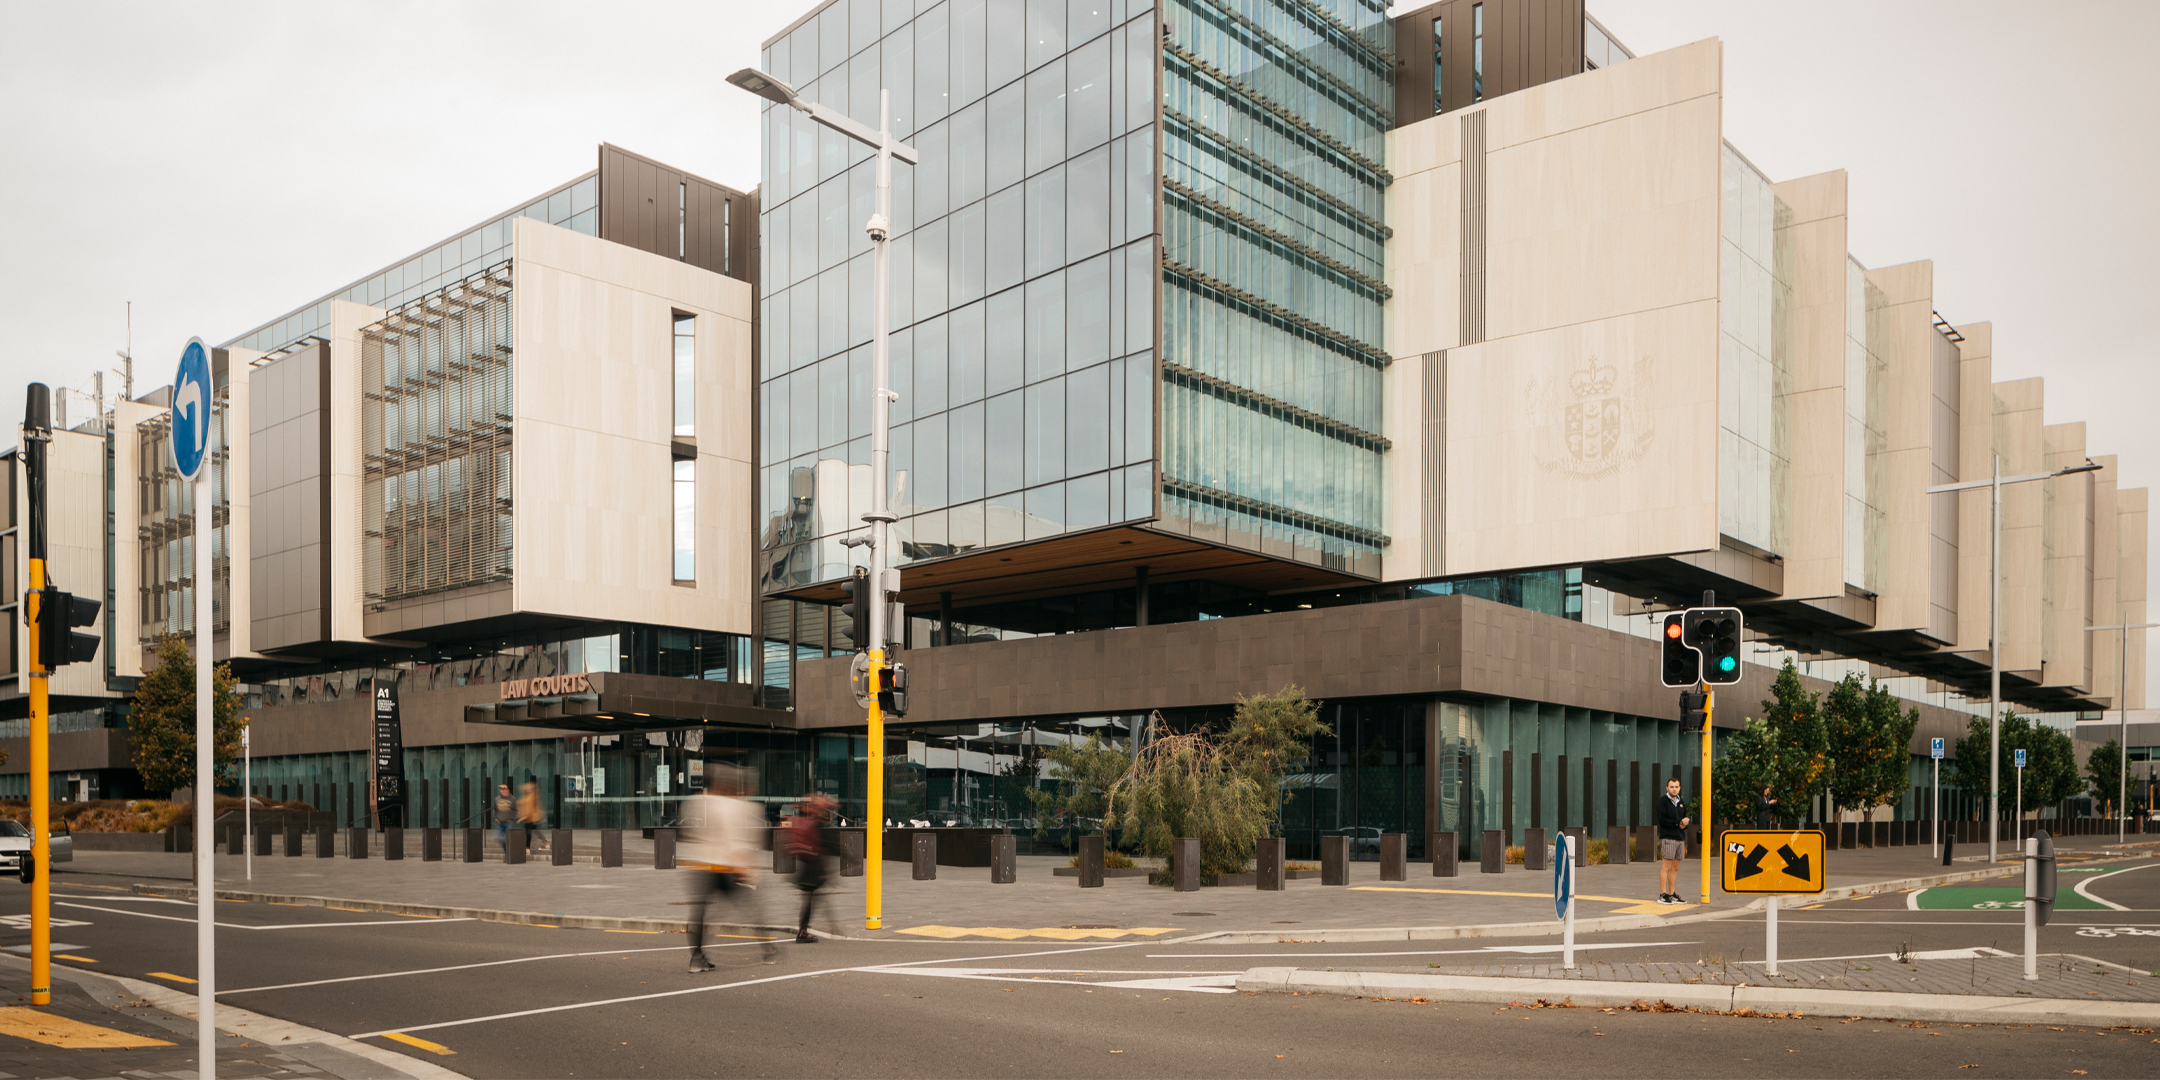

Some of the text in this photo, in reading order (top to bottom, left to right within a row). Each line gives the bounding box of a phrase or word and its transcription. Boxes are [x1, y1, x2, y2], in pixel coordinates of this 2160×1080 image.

[501, 673, 589, 699] LAW COURTS
[377, 687, 389, 698] A1
[30, 710, 36, 719] 4
